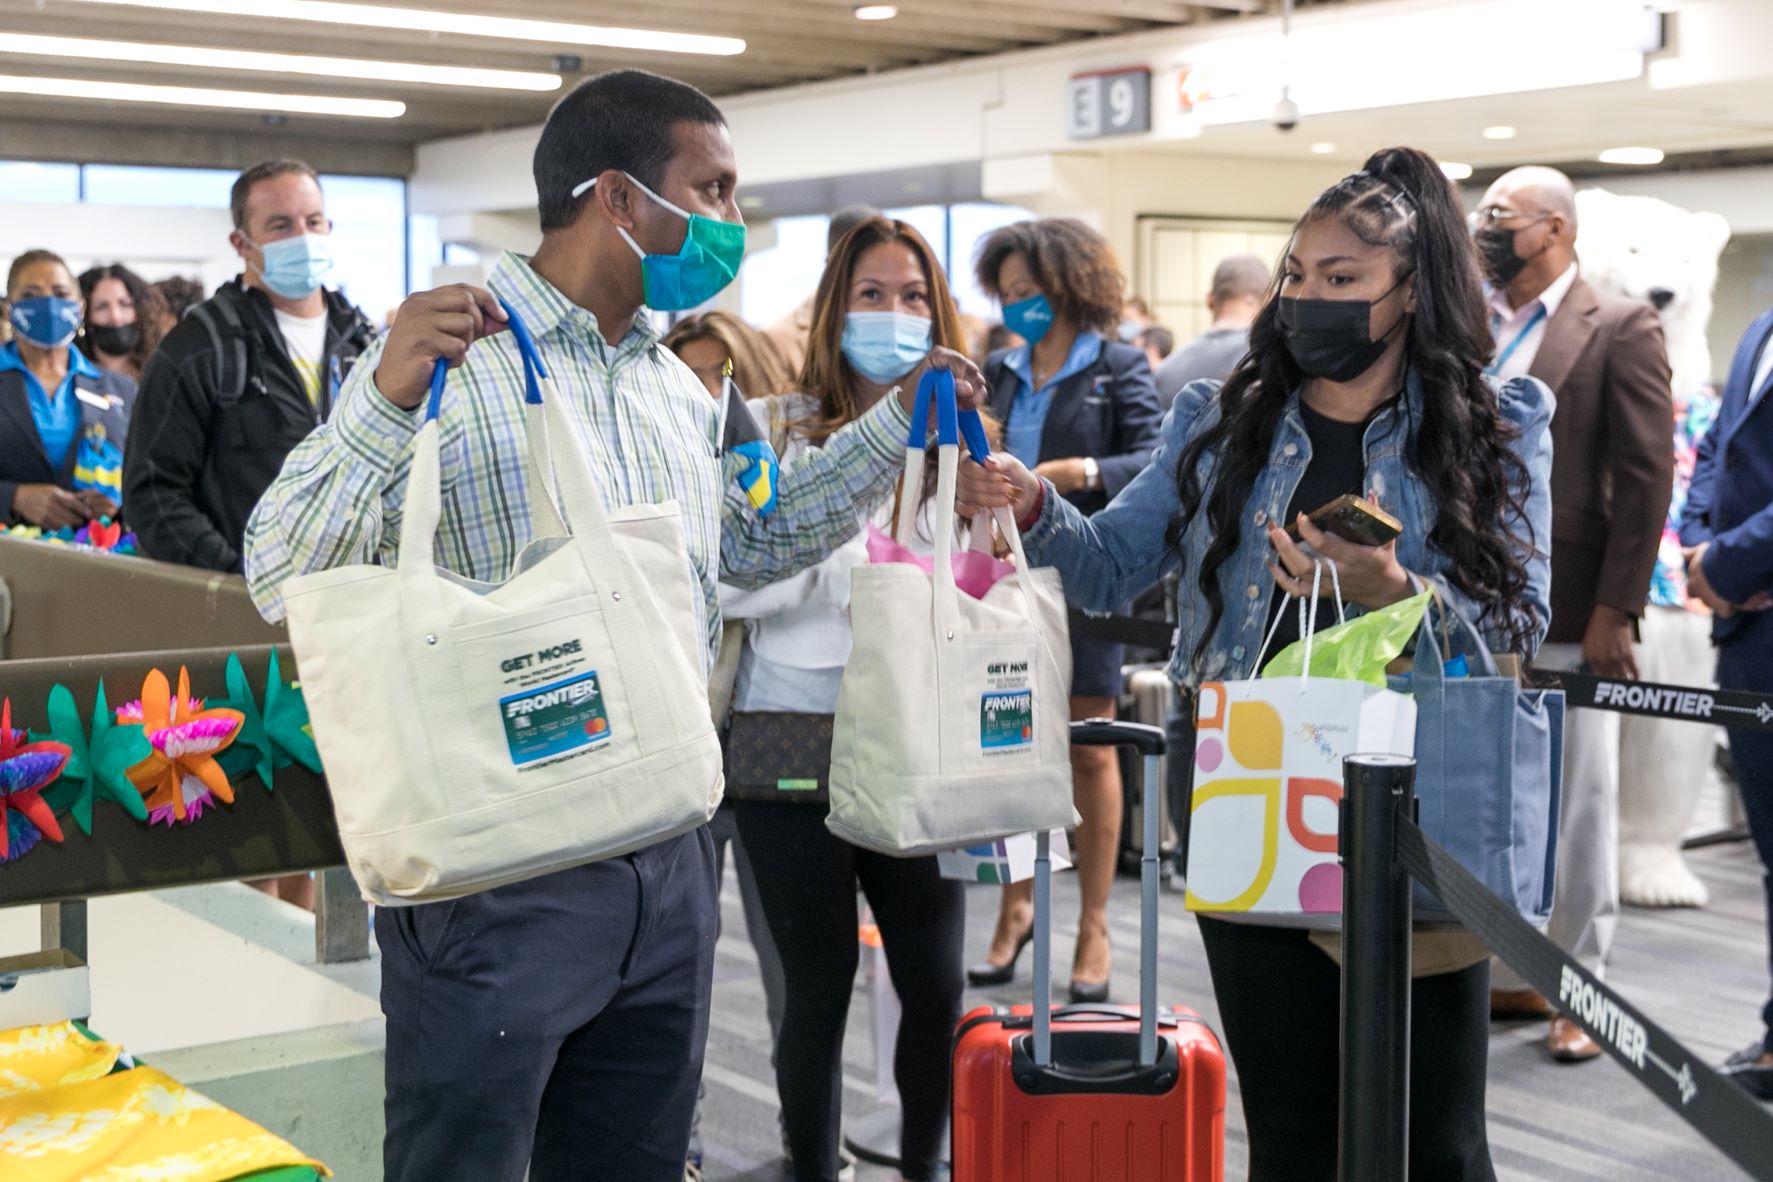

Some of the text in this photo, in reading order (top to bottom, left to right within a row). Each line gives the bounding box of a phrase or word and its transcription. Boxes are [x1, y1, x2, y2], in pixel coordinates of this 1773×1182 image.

[1073, 78, 1134, 128] E 9
[501, 638, 582, 673] GET MORE
[988, 662, 1008, 674] GET
[506, 678, 599, 718] FRONTIER
[1594, 681, 1715, 717] FRONTIER
[1559, 963, 1647, 1069] FRONTIER
